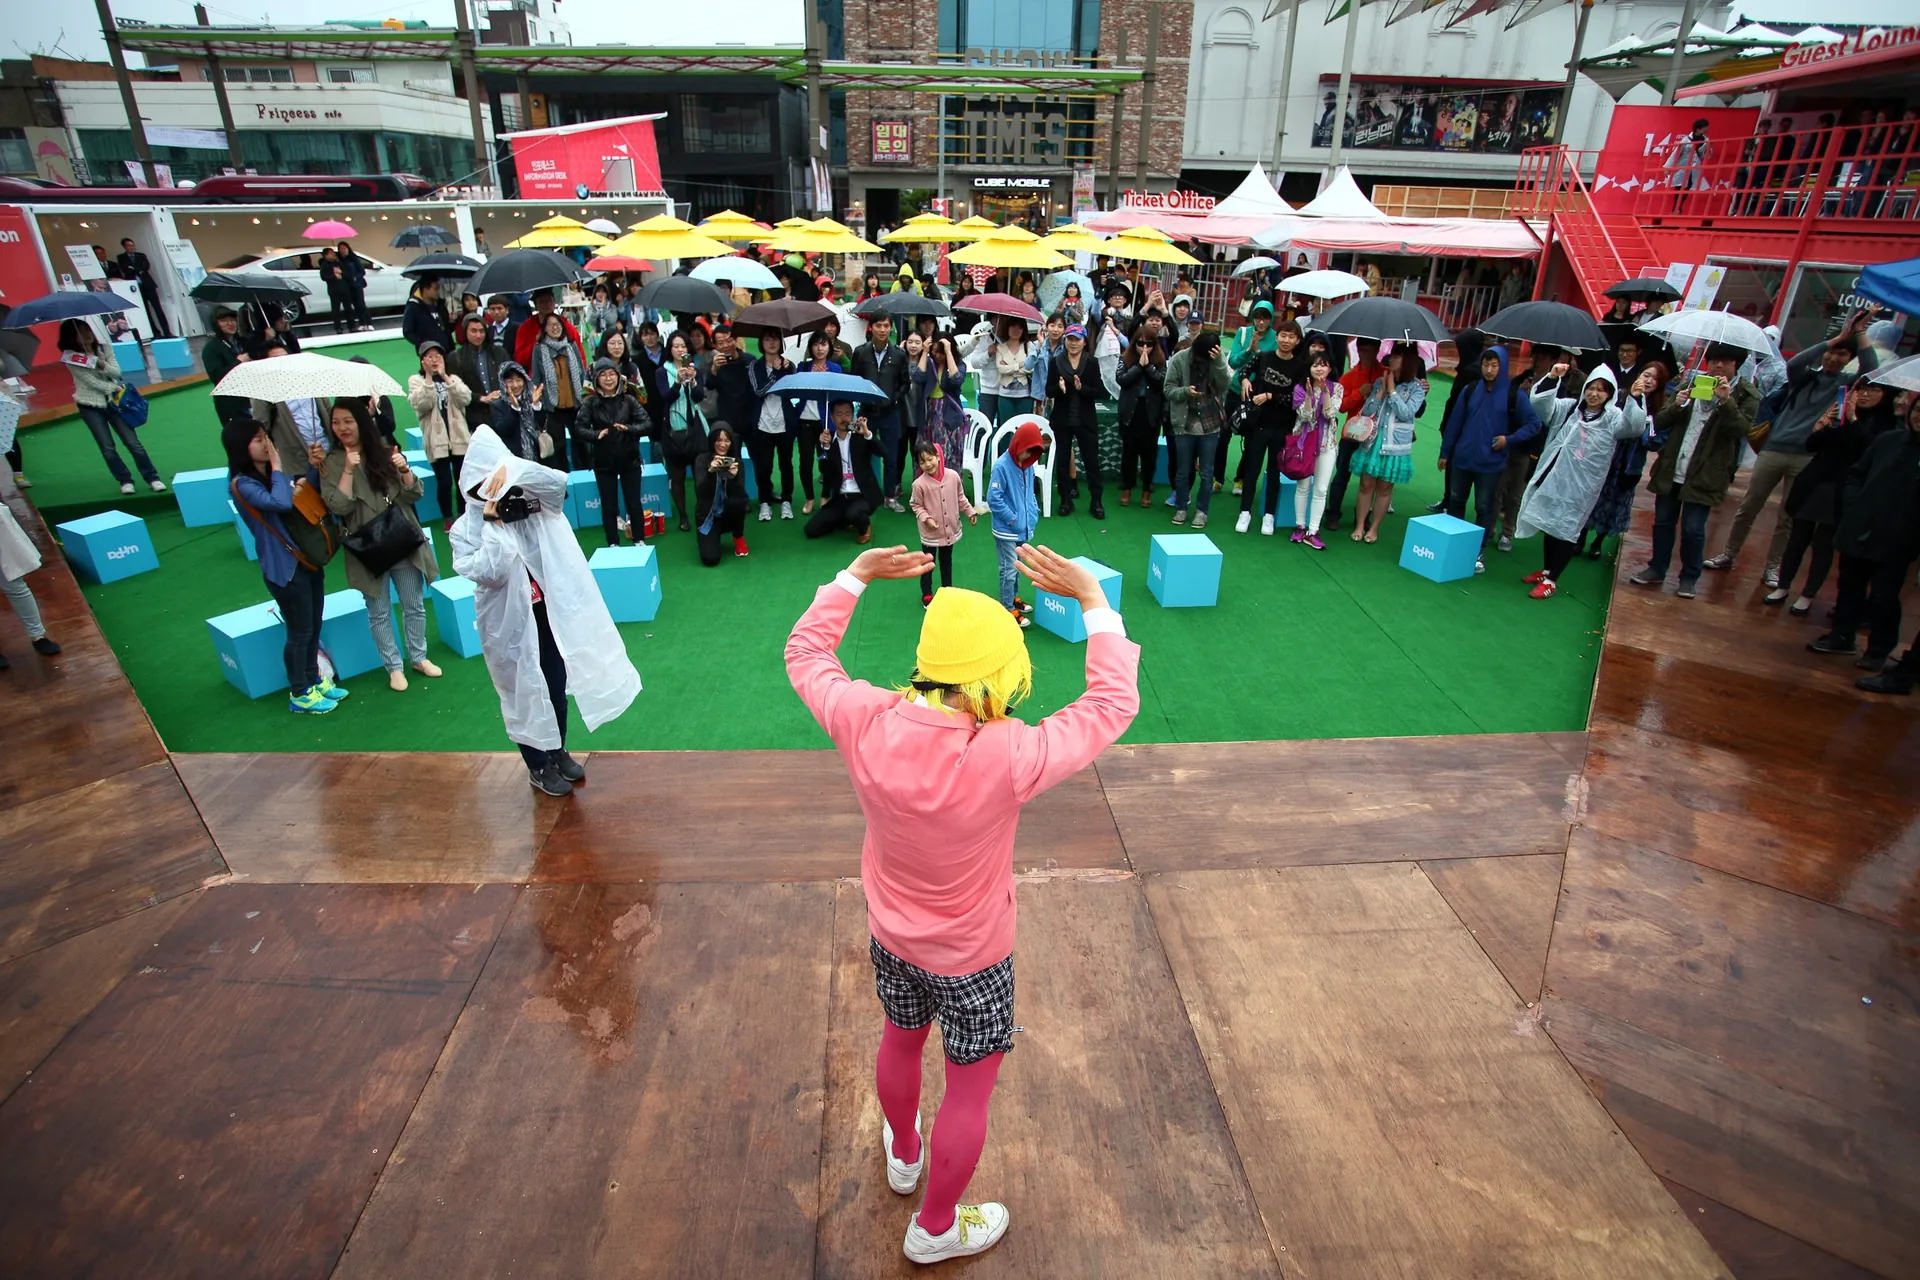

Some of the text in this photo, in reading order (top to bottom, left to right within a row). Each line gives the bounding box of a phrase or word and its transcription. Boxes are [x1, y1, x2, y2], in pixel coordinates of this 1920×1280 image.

[1781, 33, 1848, 68] Guest
[256, 103, 317, 123] Princess
[876, 124, 907, 138] 임대
[963, 111, 1066, 164] TIMES
[1355, 121, 1393, 146] 런닝맨
[876, 139, 907, 152] 문의
[974, 178, 1051, 188] CUBE MOBILE
[1123, 189, 1214, 210] Ticket Office
